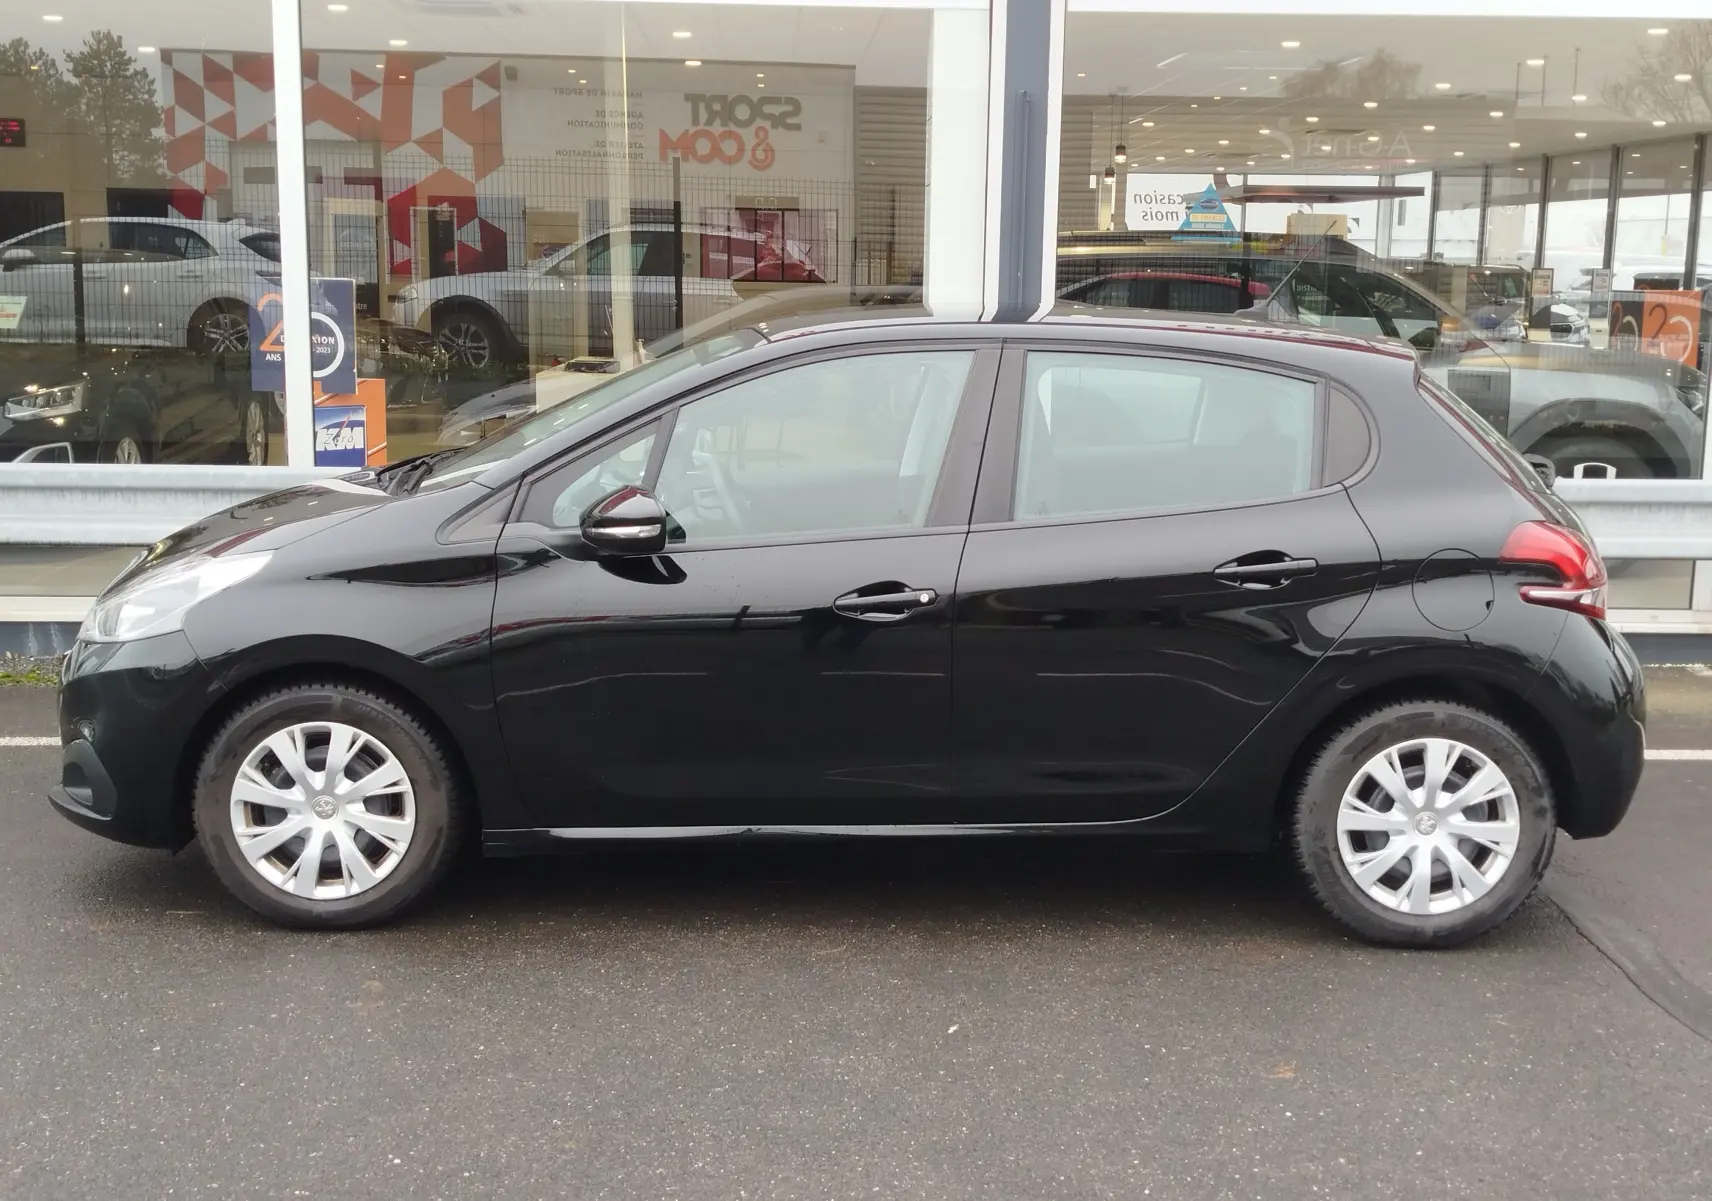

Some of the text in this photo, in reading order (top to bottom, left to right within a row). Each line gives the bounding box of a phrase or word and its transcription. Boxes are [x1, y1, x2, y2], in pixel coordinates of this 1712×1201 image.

[316, 346, 331, 354] 2023
[265, 353, 282, 361] ANS
[315, 426, 364, 451] KM
